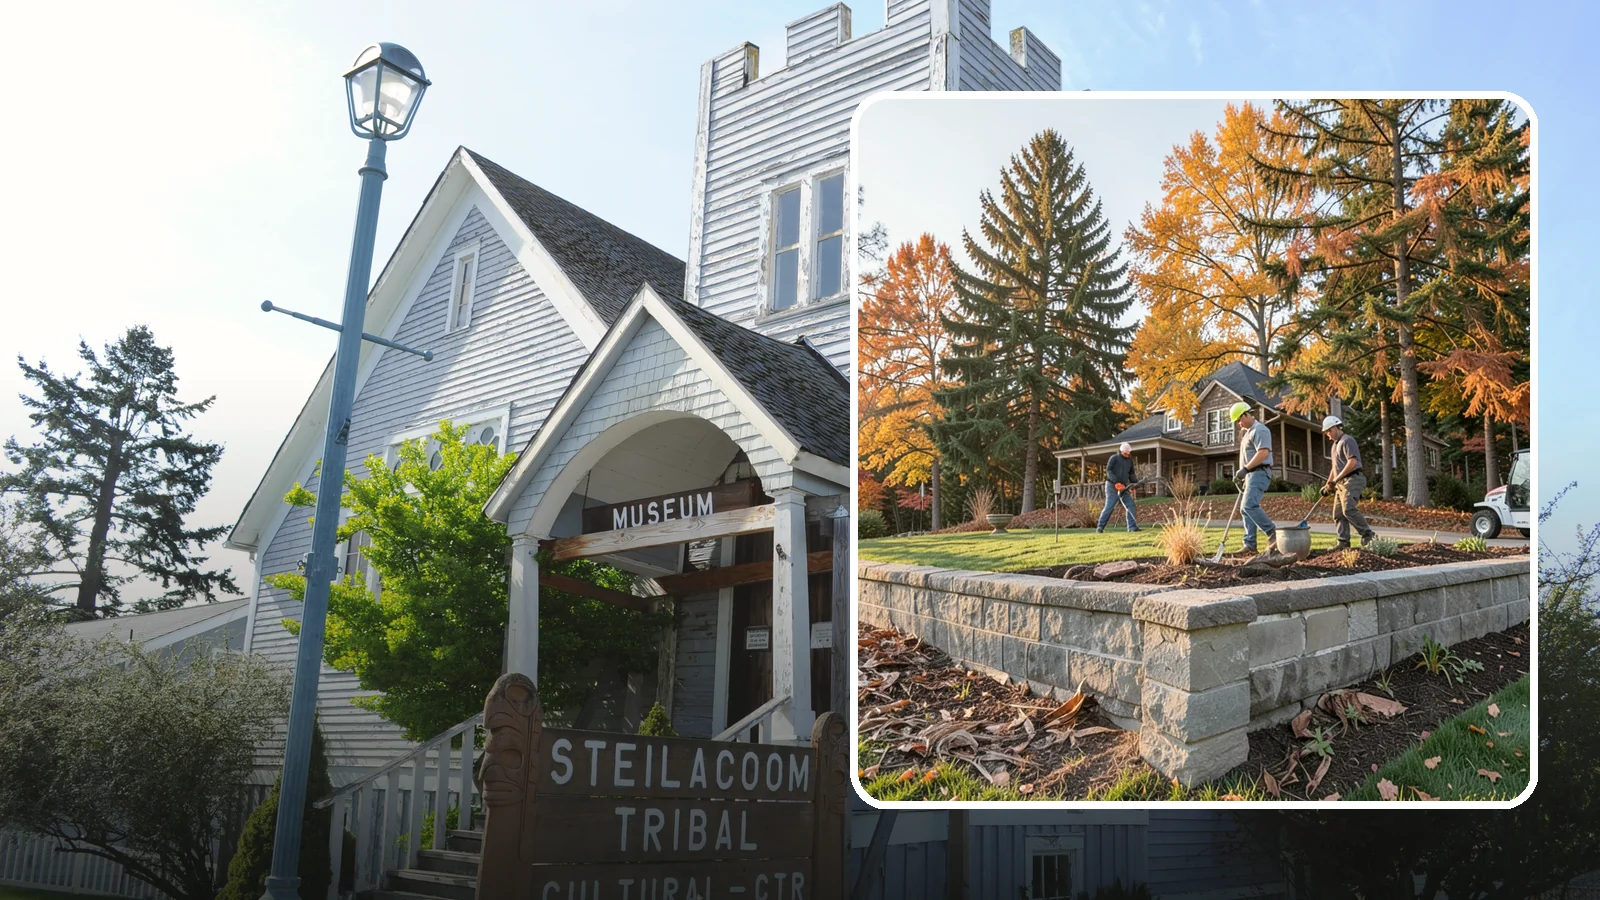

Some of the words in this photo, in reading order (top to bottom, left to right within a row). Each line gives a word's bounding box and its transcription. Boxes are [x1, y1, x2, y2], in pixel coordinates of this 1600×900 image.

[613, 491, 714, 531] MUSEUM
[551, 738, 810, 792] STEILACOOM
[615, 806, 758, 852] TRIBAL
